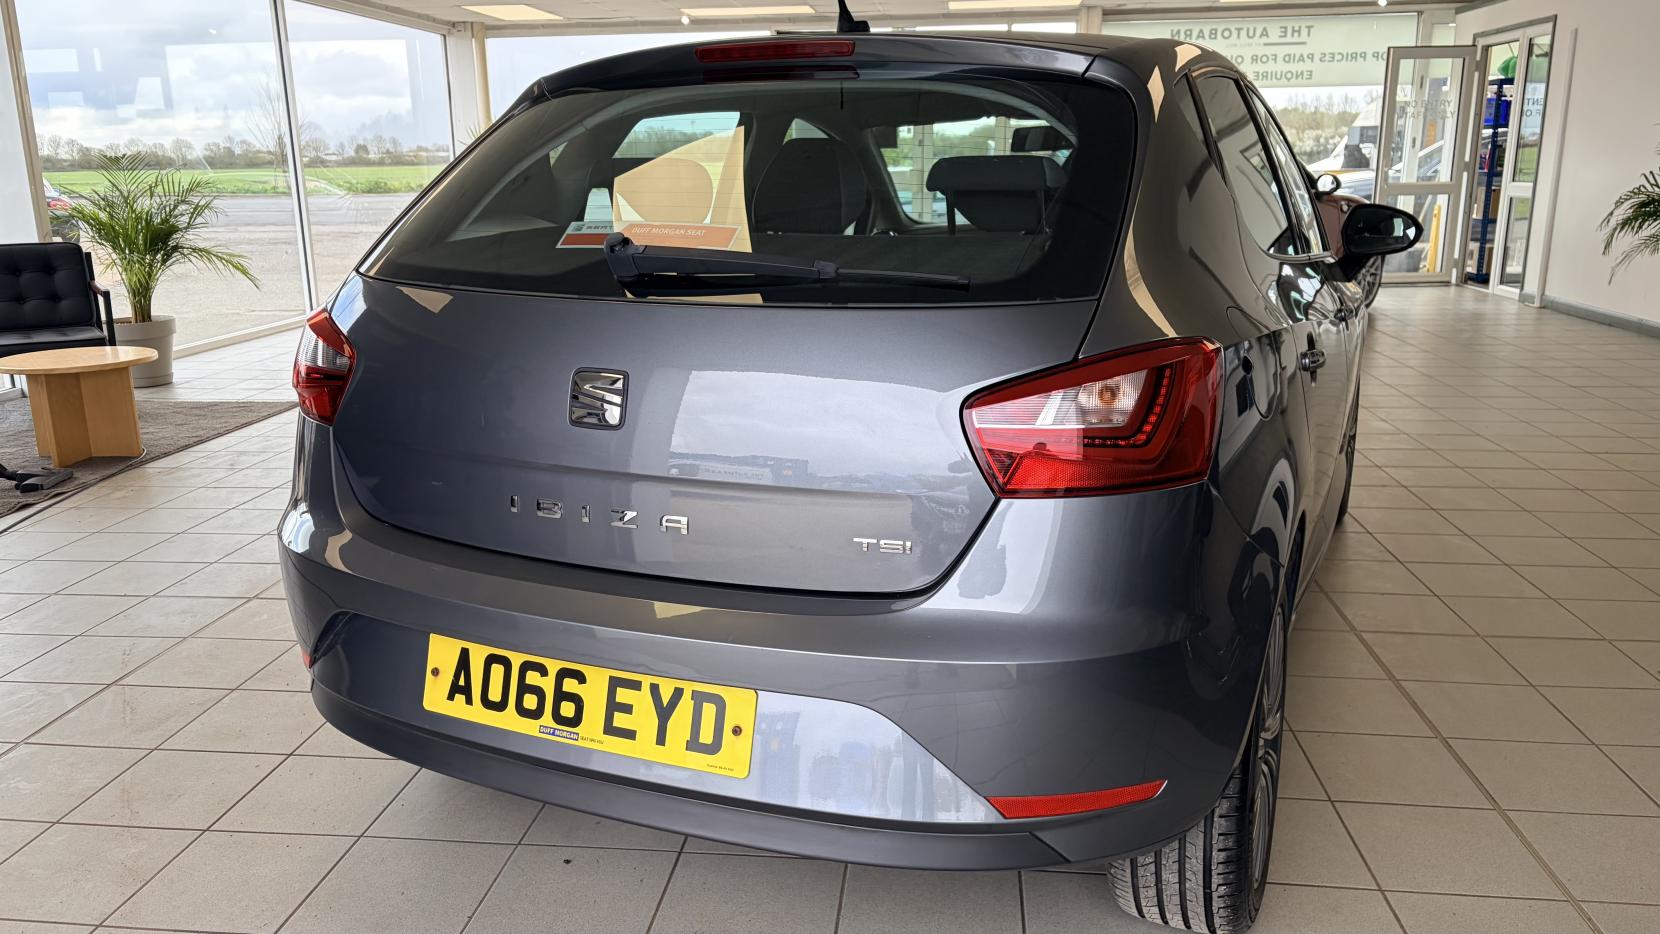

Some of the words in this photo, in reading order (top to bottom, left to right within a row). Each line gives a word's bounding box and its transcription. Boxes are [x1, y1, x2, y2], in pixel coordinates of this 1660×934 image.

[652, 228, 685, 236] MORGAN
[510, 495, 689, 535] IBIZA
[853, 537, 912, 554] TSI
[446, 647, 588, 729] AO66
[602, 675, 727, 756] EYD
[540, 726, 554, 735] DUFF
[554, 730, 579, 740] MORGAN
